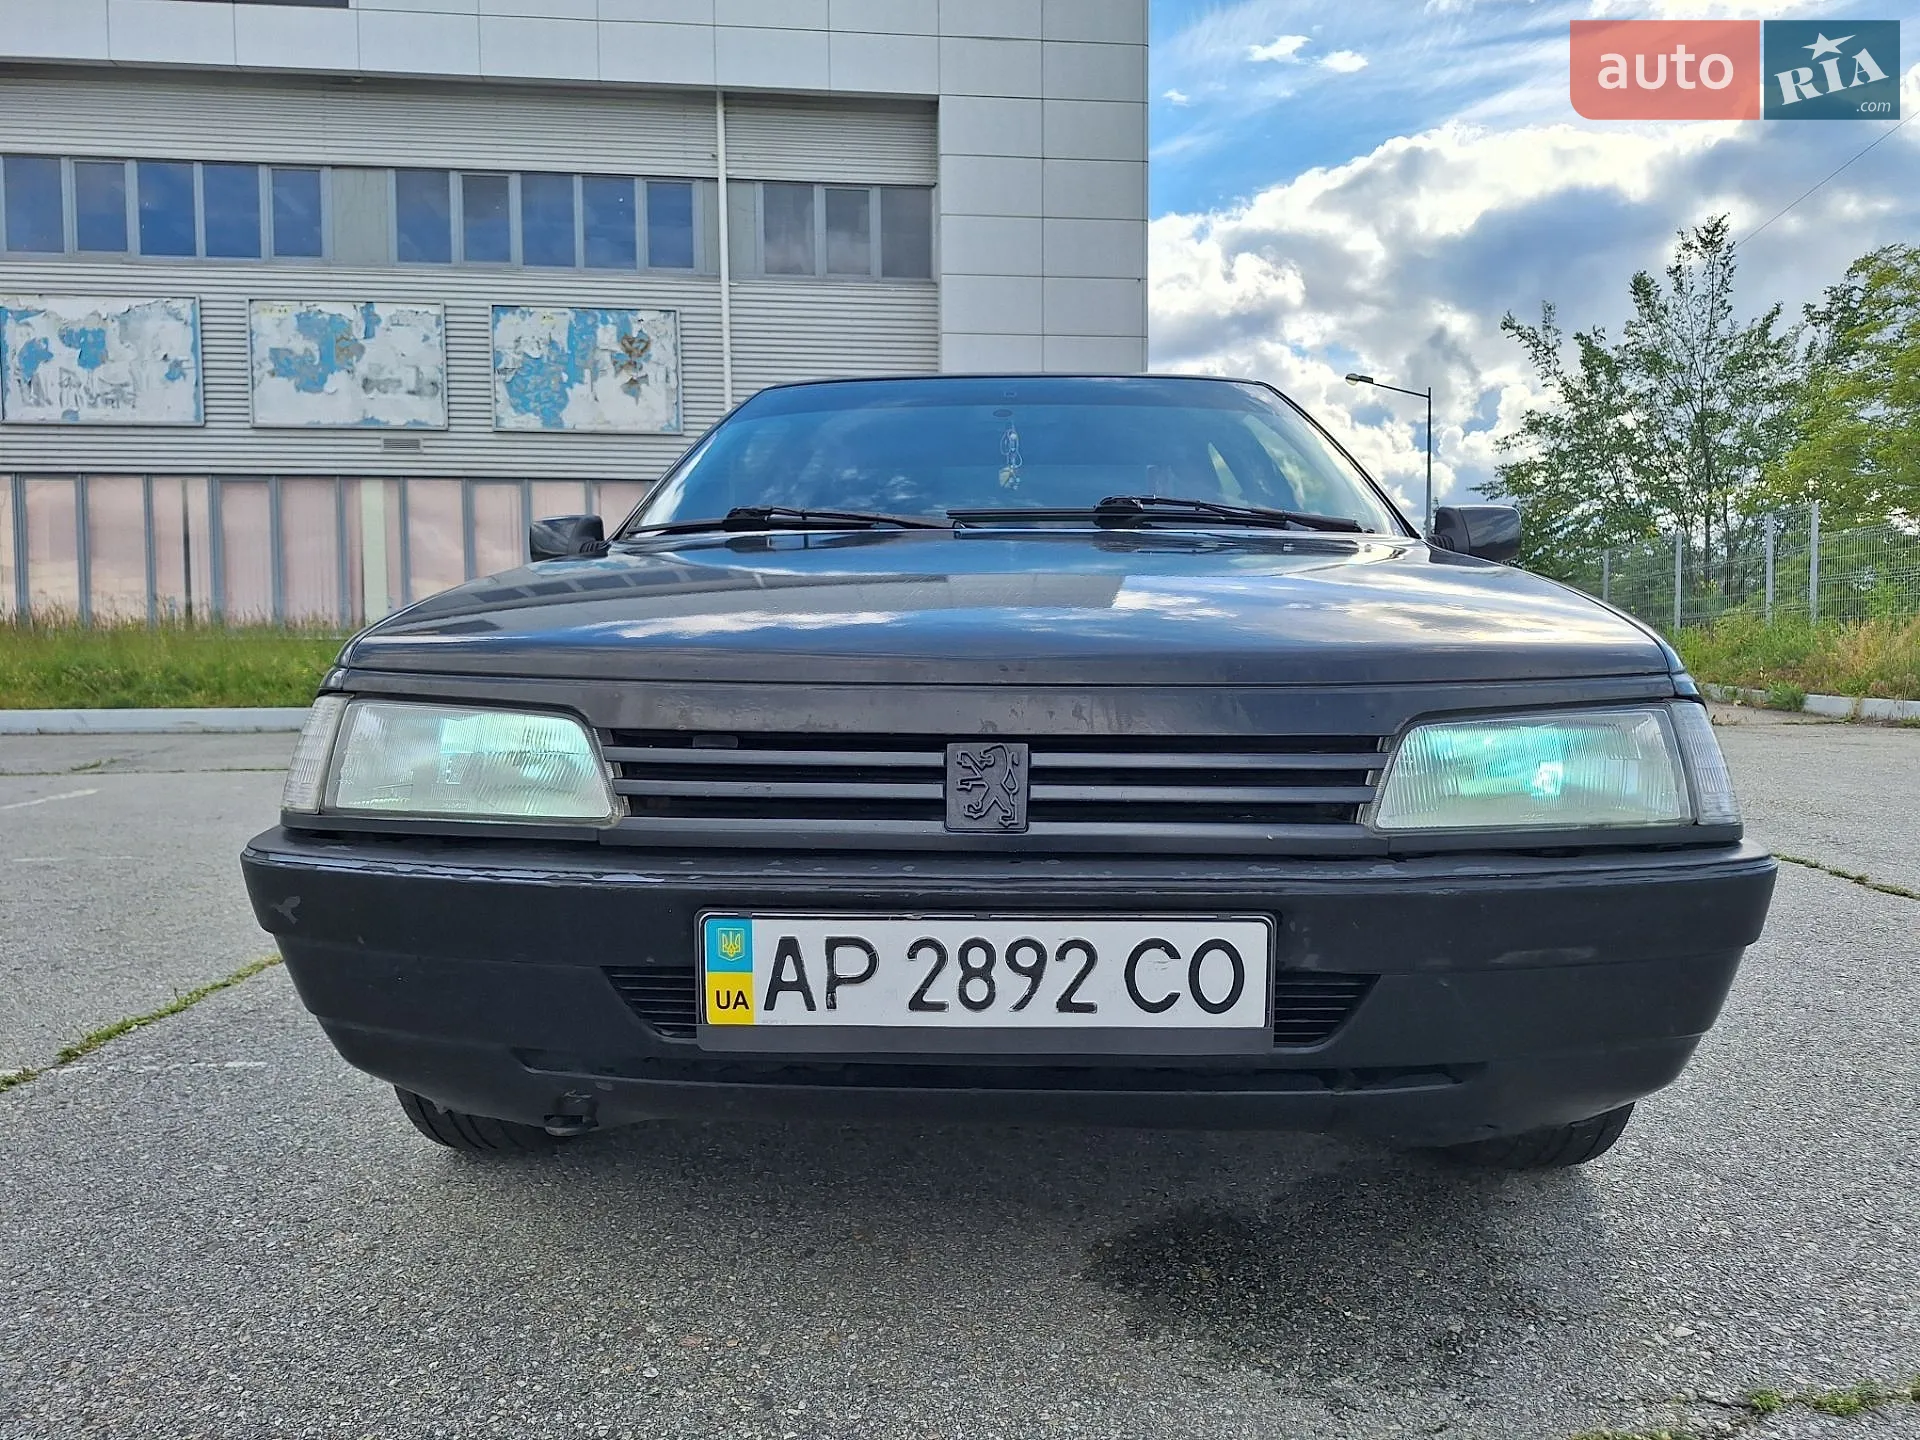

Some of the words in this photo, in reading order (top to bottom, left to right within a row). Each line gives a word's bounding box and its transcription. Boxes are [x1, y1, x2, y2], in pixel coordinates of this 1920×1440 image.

[715, 989, 750, 1010] UA
[763, 936, 880, 1012] AP
[906, 937, 1099, 1013] 2892
[1124, 937, 1246, 1015] CO
